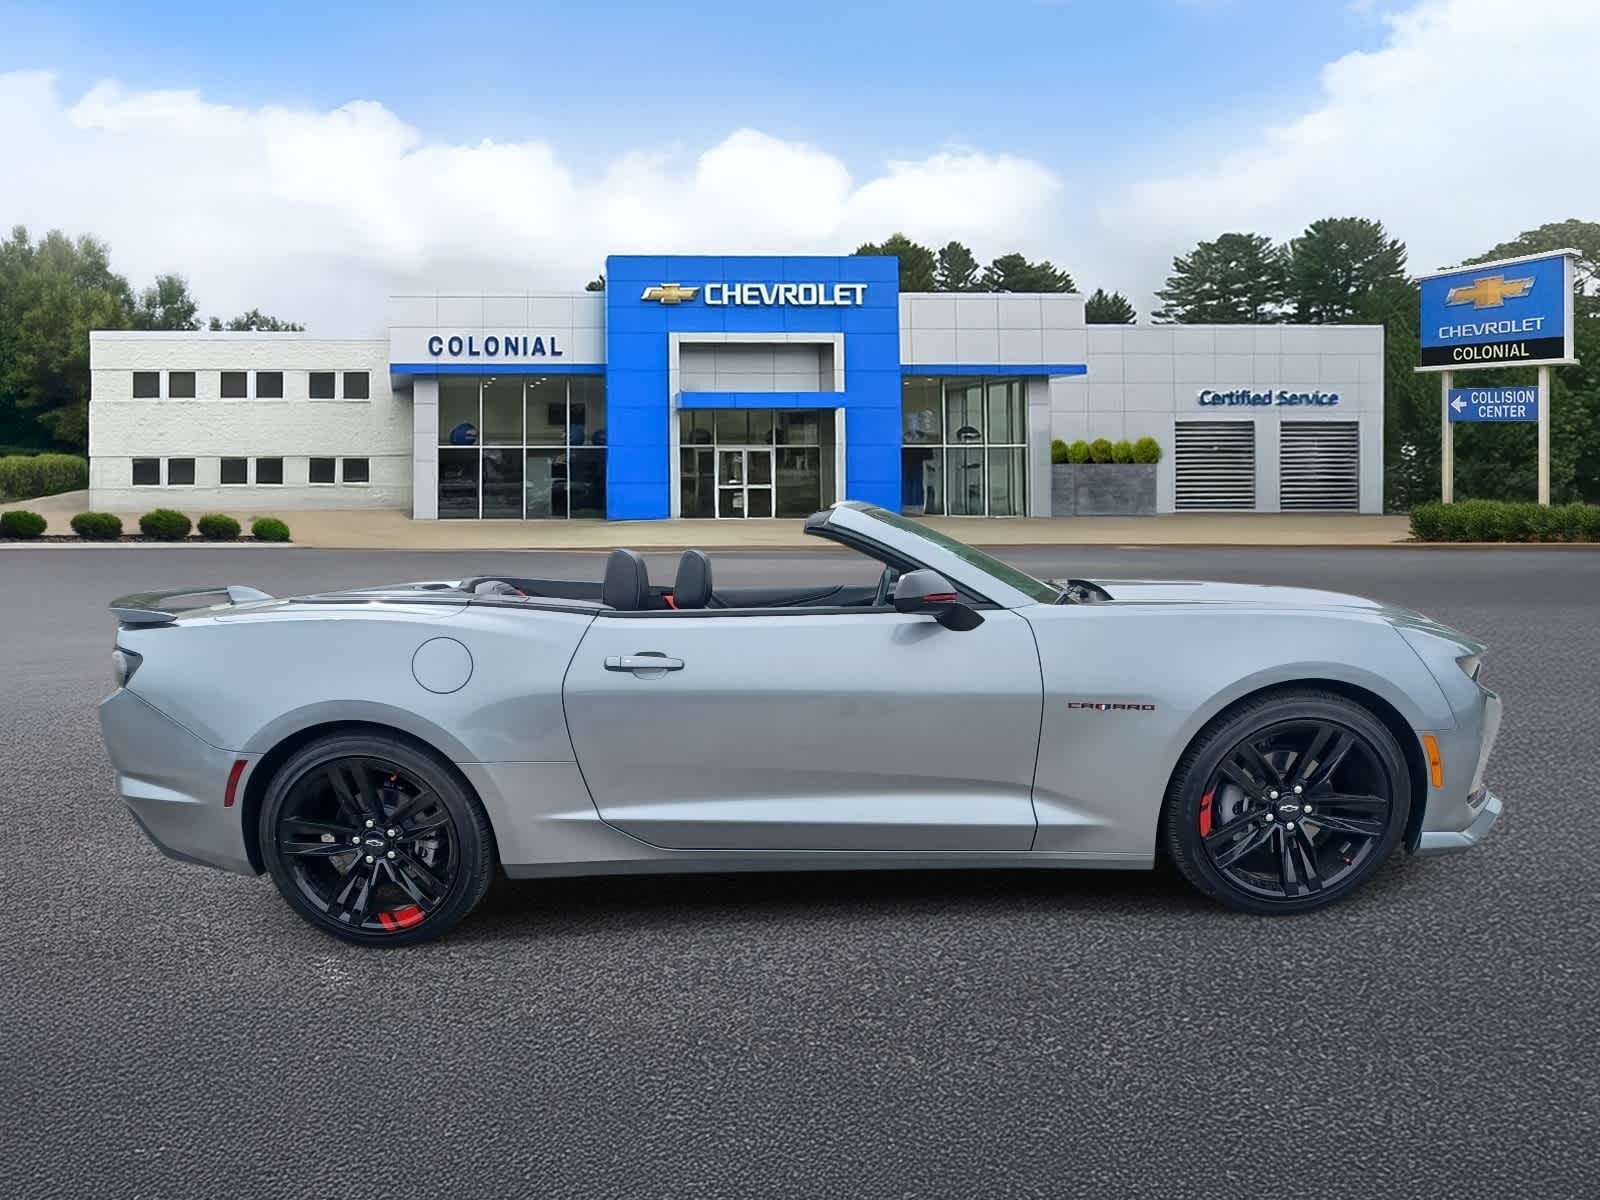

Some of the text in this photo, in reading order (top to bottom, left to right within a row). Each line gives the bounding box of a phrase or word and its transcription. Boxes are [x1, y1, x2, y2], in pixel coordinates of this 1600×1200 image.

[704, 283, 867, 305] CHEVROLET
[1438, 316, 1545, 339] CHEVROLET
[428, 336, 563, 357] COLONIAL
[1452, 342, 1530, 361] COLONIAL
[1199, 389, 1339, 406] Certified Service
[1470, 390, 1535, 405] COLLISION
[1478, 405, 1526, 418] CENTER
